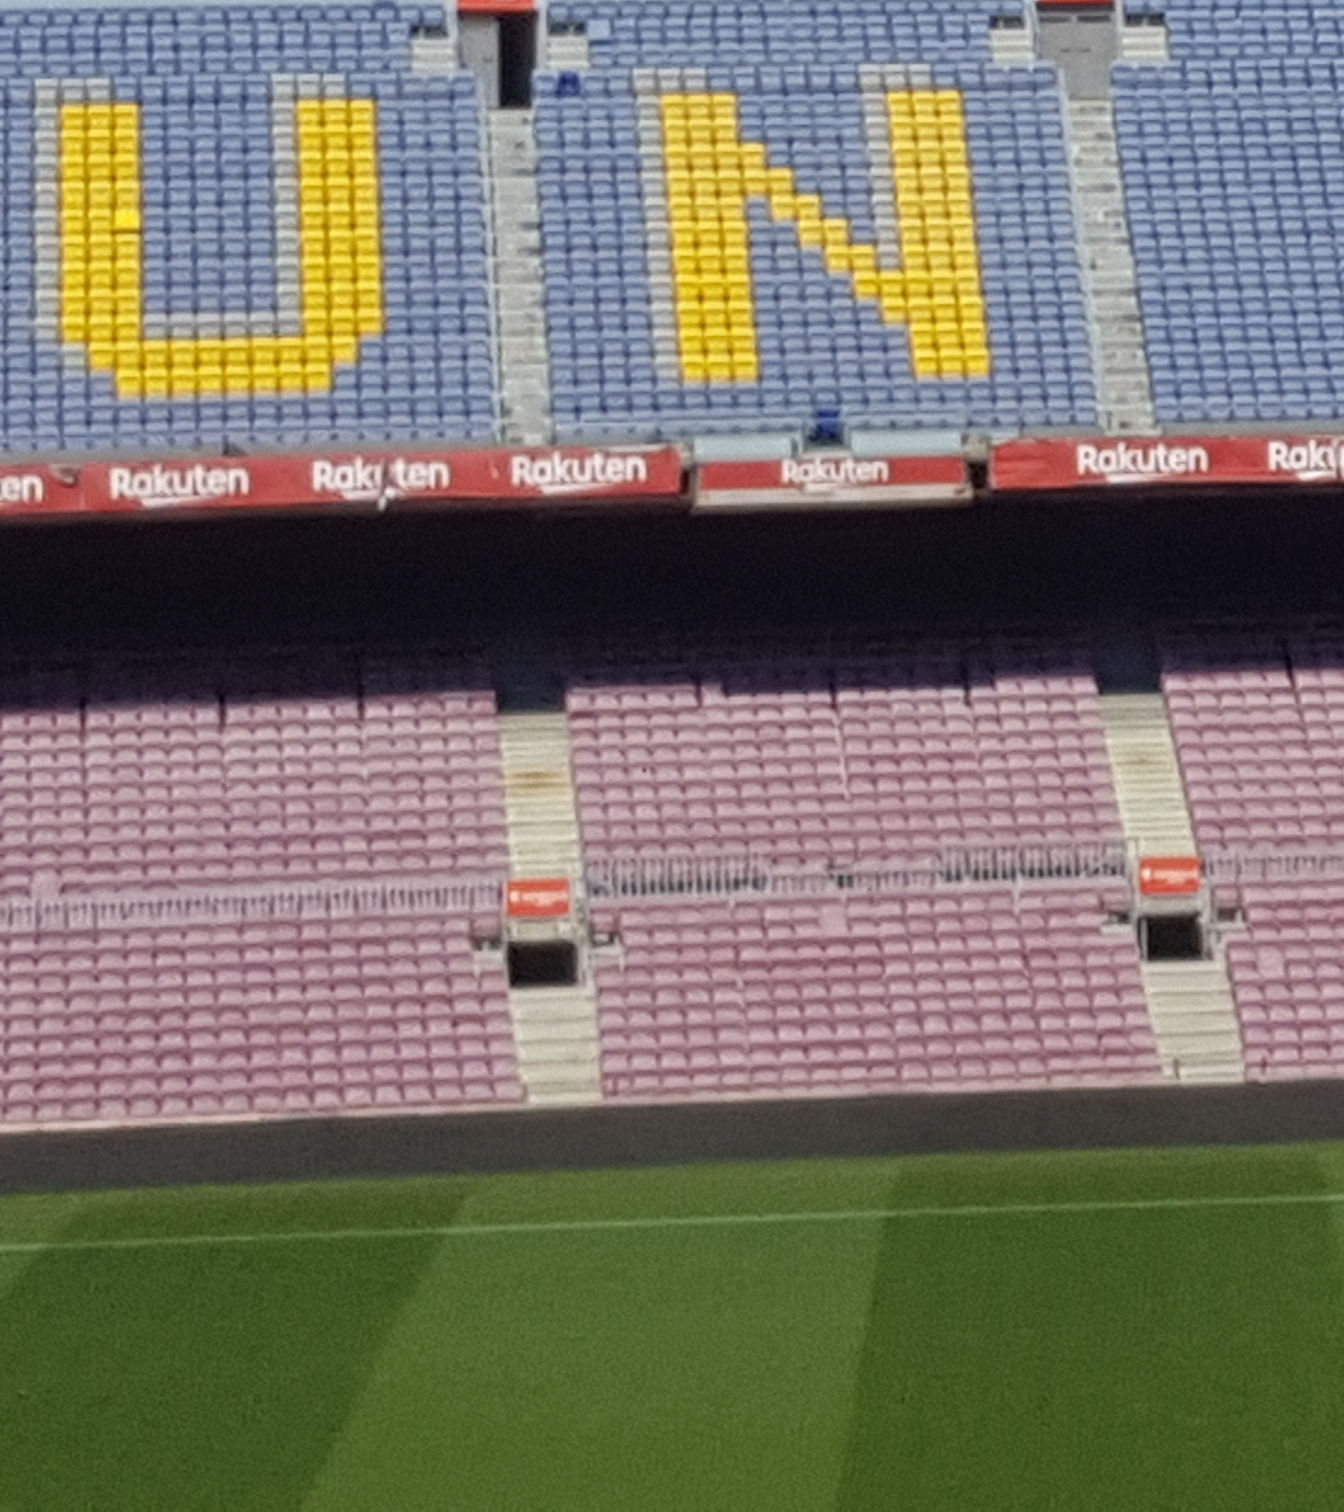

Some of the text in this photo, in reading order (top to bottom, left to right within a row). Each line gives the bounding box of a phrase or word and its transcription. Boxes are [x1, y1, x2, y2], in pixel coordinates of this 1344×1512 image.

[59, 89, 989, 397] UN
[512, 451, 647, 488] Rakuten
[782, 455, 888, 483] Rakuten
[1078, 440, 1207, 475] Rakuten
[111, 464, 248, 498] Rakuten
